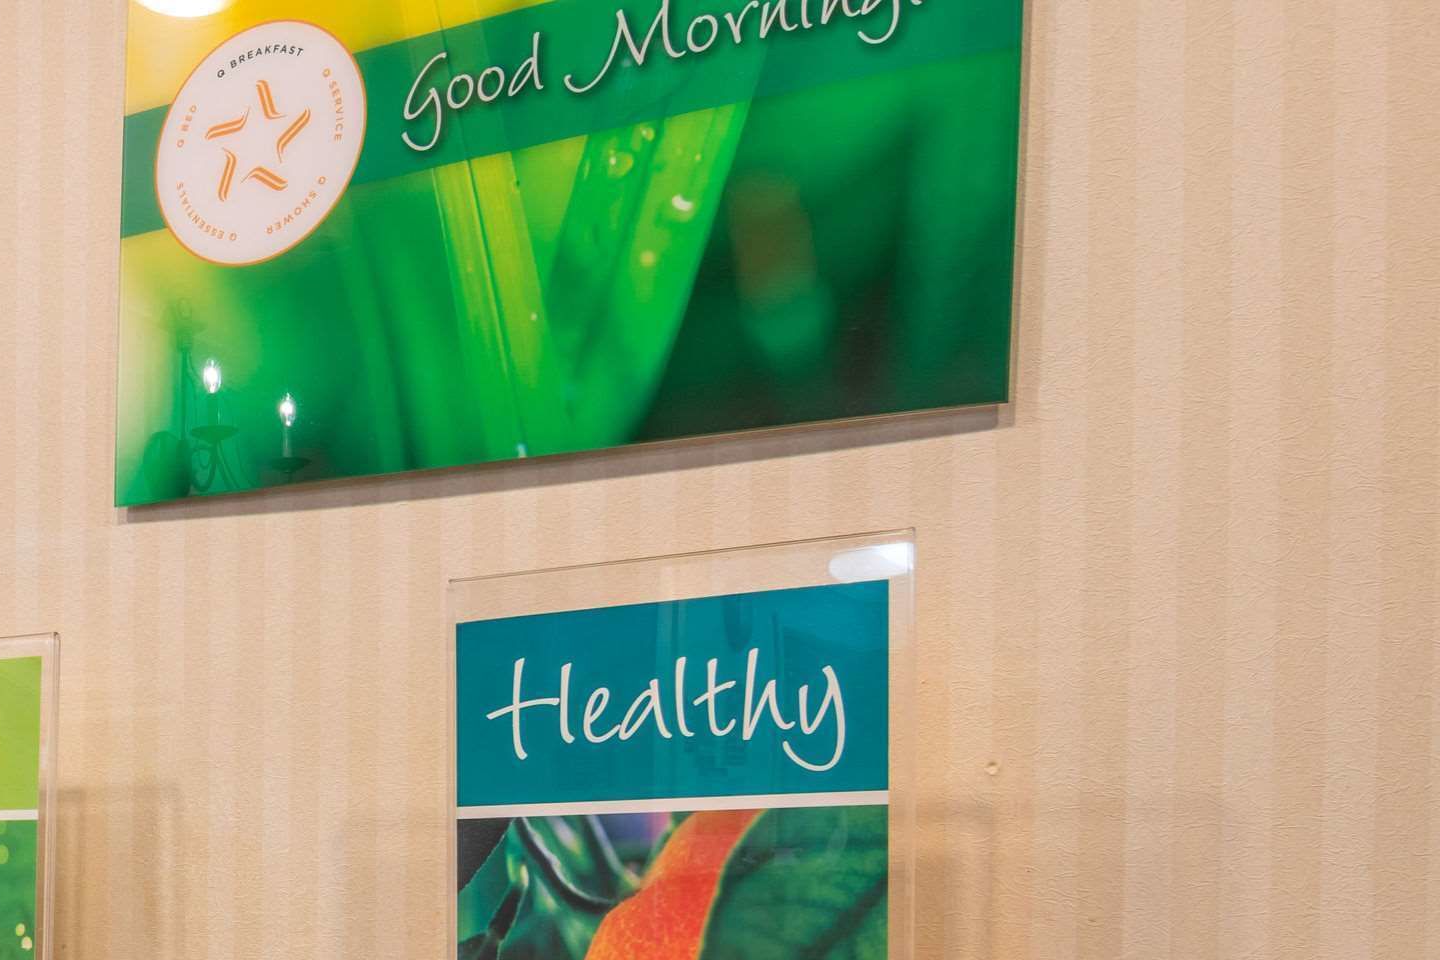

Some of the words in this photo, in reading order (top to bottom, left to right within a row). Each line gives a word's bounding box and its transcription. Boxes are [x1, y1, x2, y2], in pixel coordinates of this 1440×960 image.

[217, 69, 226, 78] Q
[229, 44, 304, 69] BREAKFAST
[401, 32, 544, 152] Good
[563, 0, 922, 94] Morning
[180, 104, 198, 132] BED
[328, 80, 344, 142] SERVICE
[176, 181, 225, 240] ESSENTIALS
[265, 190, 317, 235] SHOWER
[486, 647, 846, 772] Healthy
